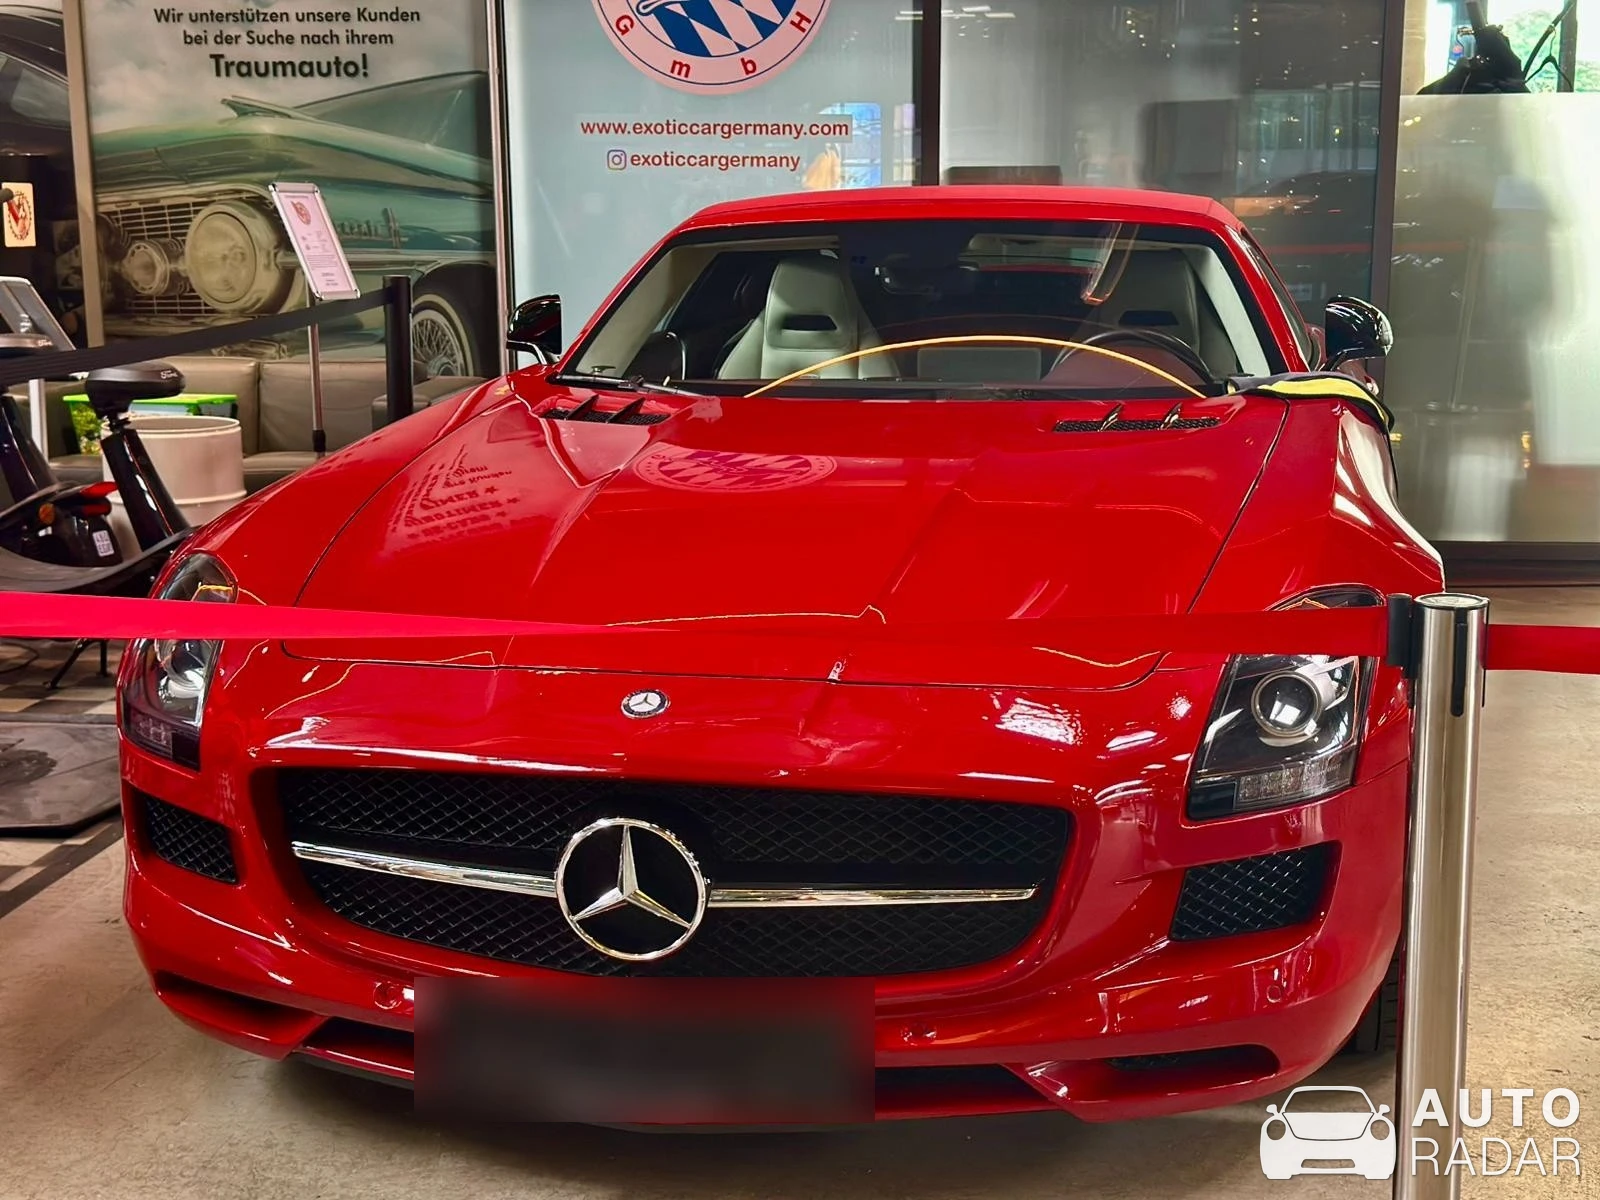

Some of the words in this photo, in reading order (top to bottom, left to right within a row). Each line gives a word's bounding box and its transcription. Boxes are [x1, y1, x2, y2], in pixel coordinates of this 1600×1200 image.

[154, 8, 184, 23] Wir
[188, 8, 290, 23] unterstützen
[296, 10, 351, 23] unsere
[357, 7, 421, 22] Kunden
[183, 30, 208, 45] bei
[213, 30, 241, 45] der
[246, 30, 295, 45] Suche
[300, 30, 340, 45] nach
[345, 30, 394, 45] ihrem
[209, 53, 369, 78] Traumauto!
[580, 119, 849, 140] www.exoticcargermany.com
[630, 151, 801, 172] exoticcargermany
